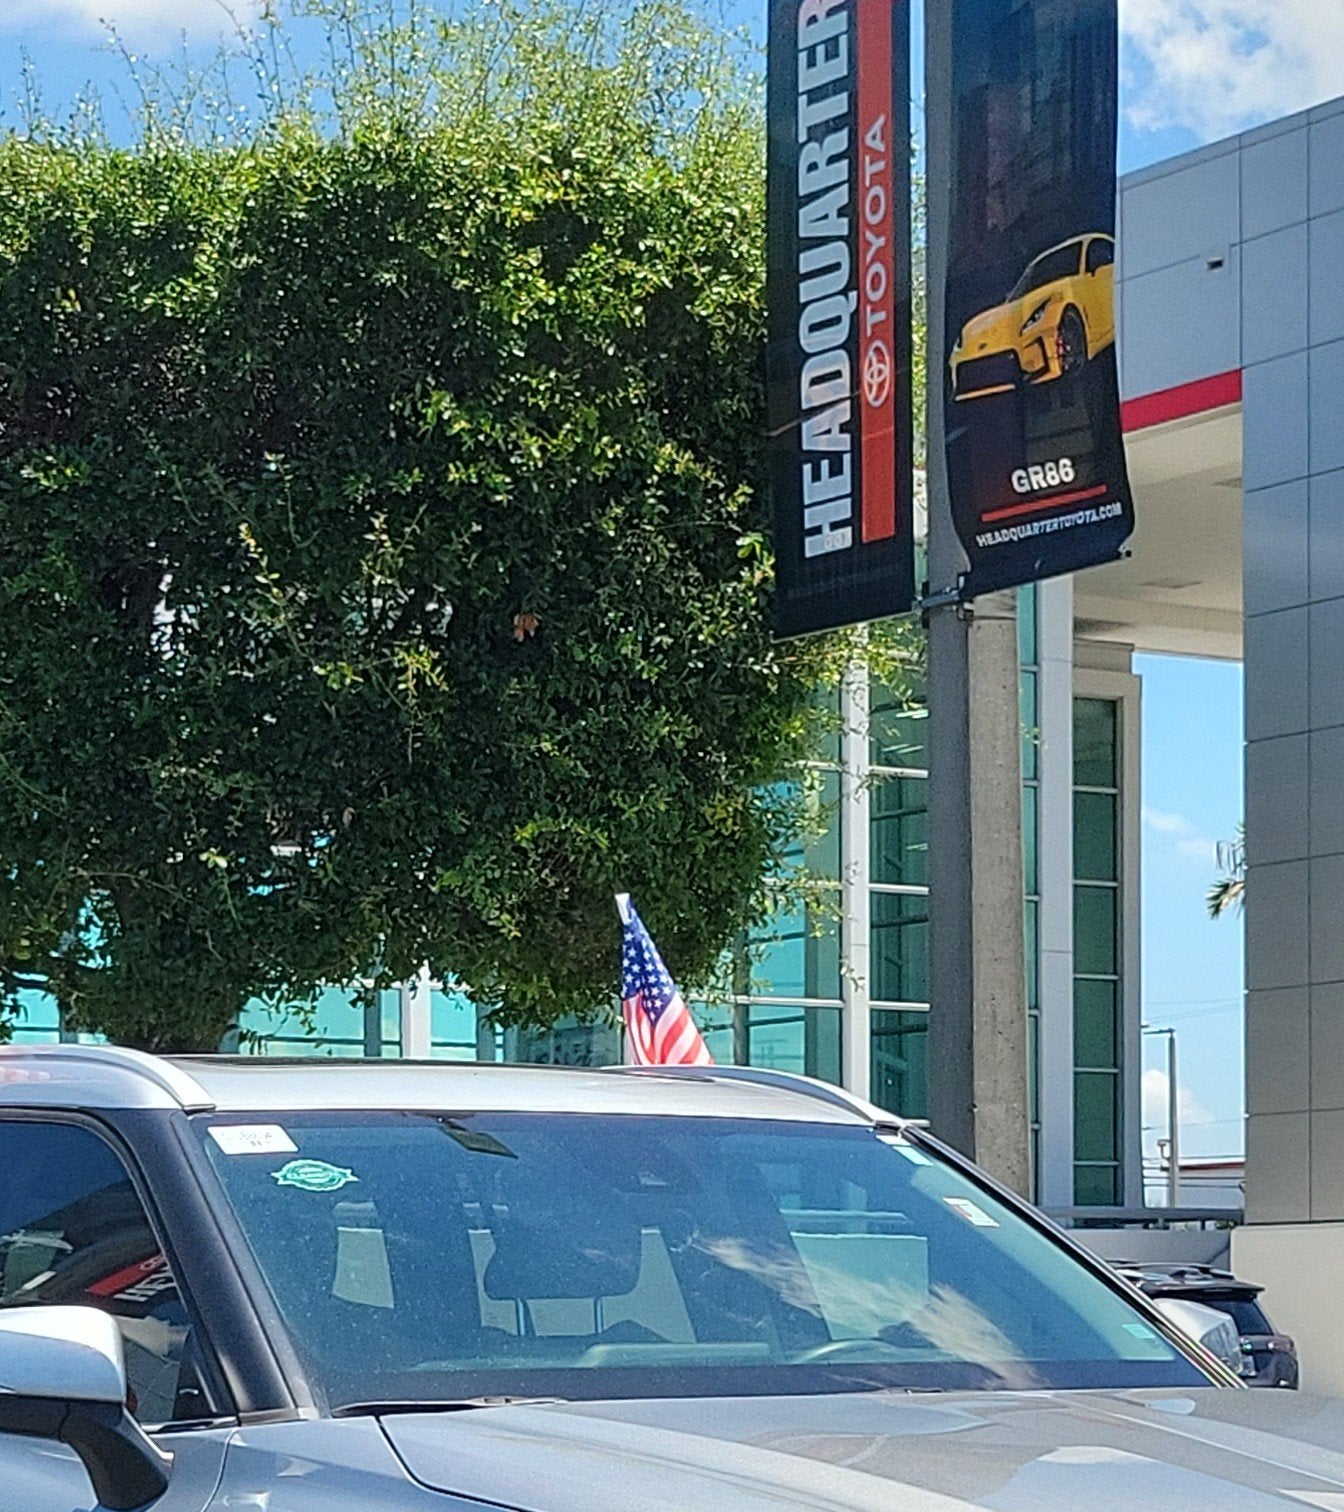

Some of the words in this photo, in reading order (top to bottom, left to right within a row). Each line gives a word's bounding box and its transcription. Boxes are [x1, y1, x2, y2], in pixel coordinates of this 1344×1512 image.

[798, 0, 857, 557] HEADQUARTER
[864, 114, 887, 338] TOYOTA
[975, 501, 1123, 548] HEADQUARTERTOYOTA.COM
[1011, 457, 1076, 494] GR86
